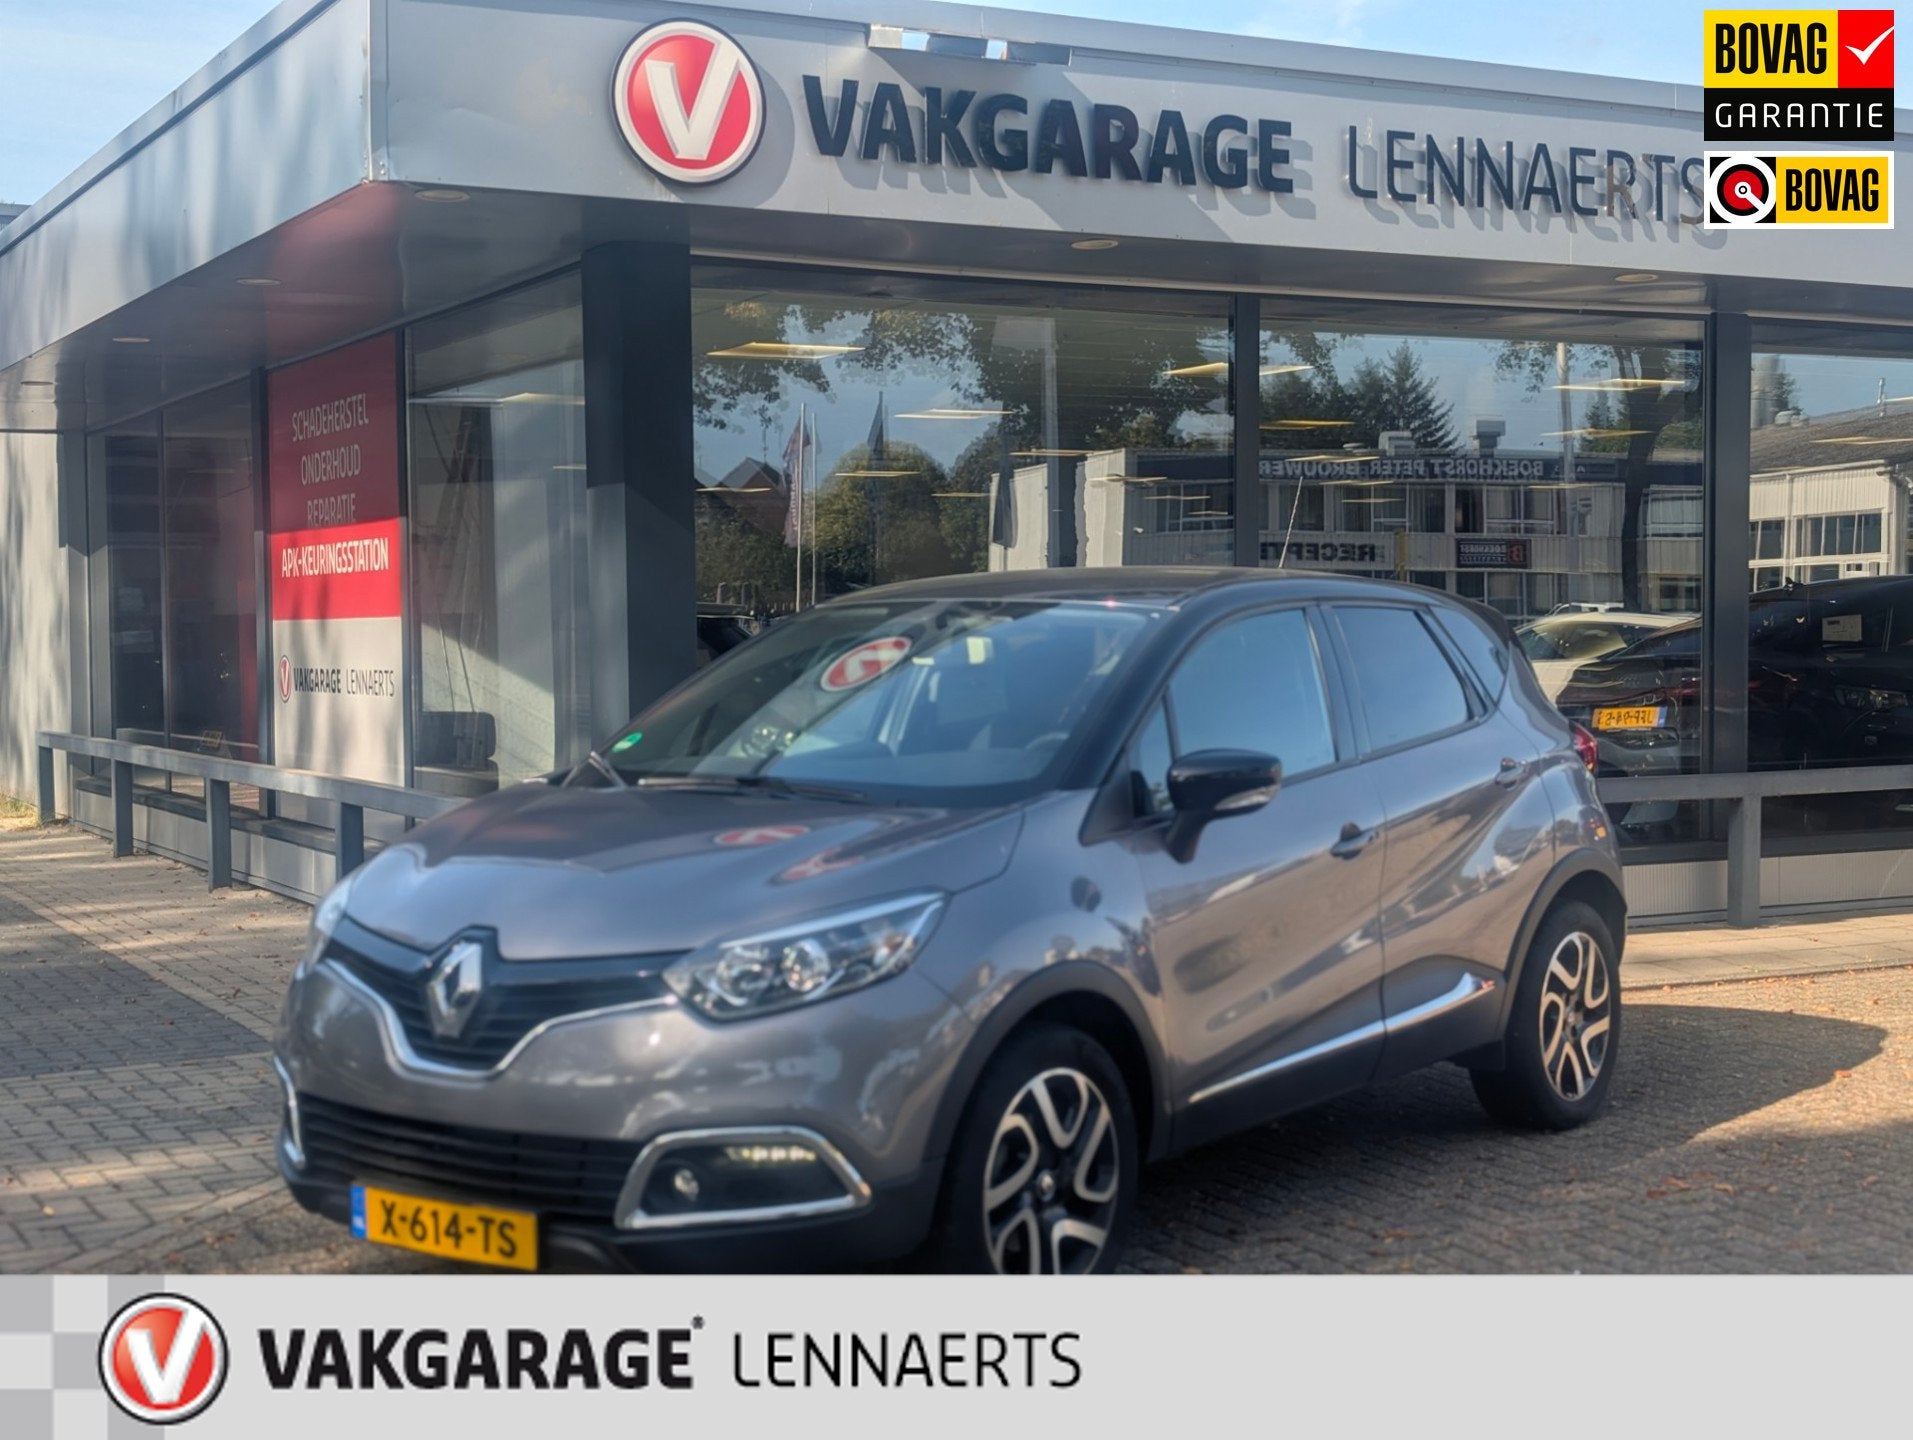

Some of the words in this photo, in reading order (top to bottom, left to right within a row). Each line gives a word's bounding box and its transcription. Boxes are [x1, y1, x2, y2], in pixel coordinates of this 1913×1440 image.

[645, 38, 742, 161] V
[801, 74, 1293, 193] VAKGARAGE
[1348, 124, 1704, 225] LENNAERTS
[292, 393, 369, 442] SCHADEHERSTEL
[301, 444, 361, 486] ONDERHOUD
[307, 493, 356, 529] REPARATIE
[281, 537, 389, 578] APK-KEURINGSSTATION
[293, 667, 342, 694] VAKGARAGE
[346, 669, 395, 697] LENNAERTS
[381, 1199, 517, 1259] X-614-TS
